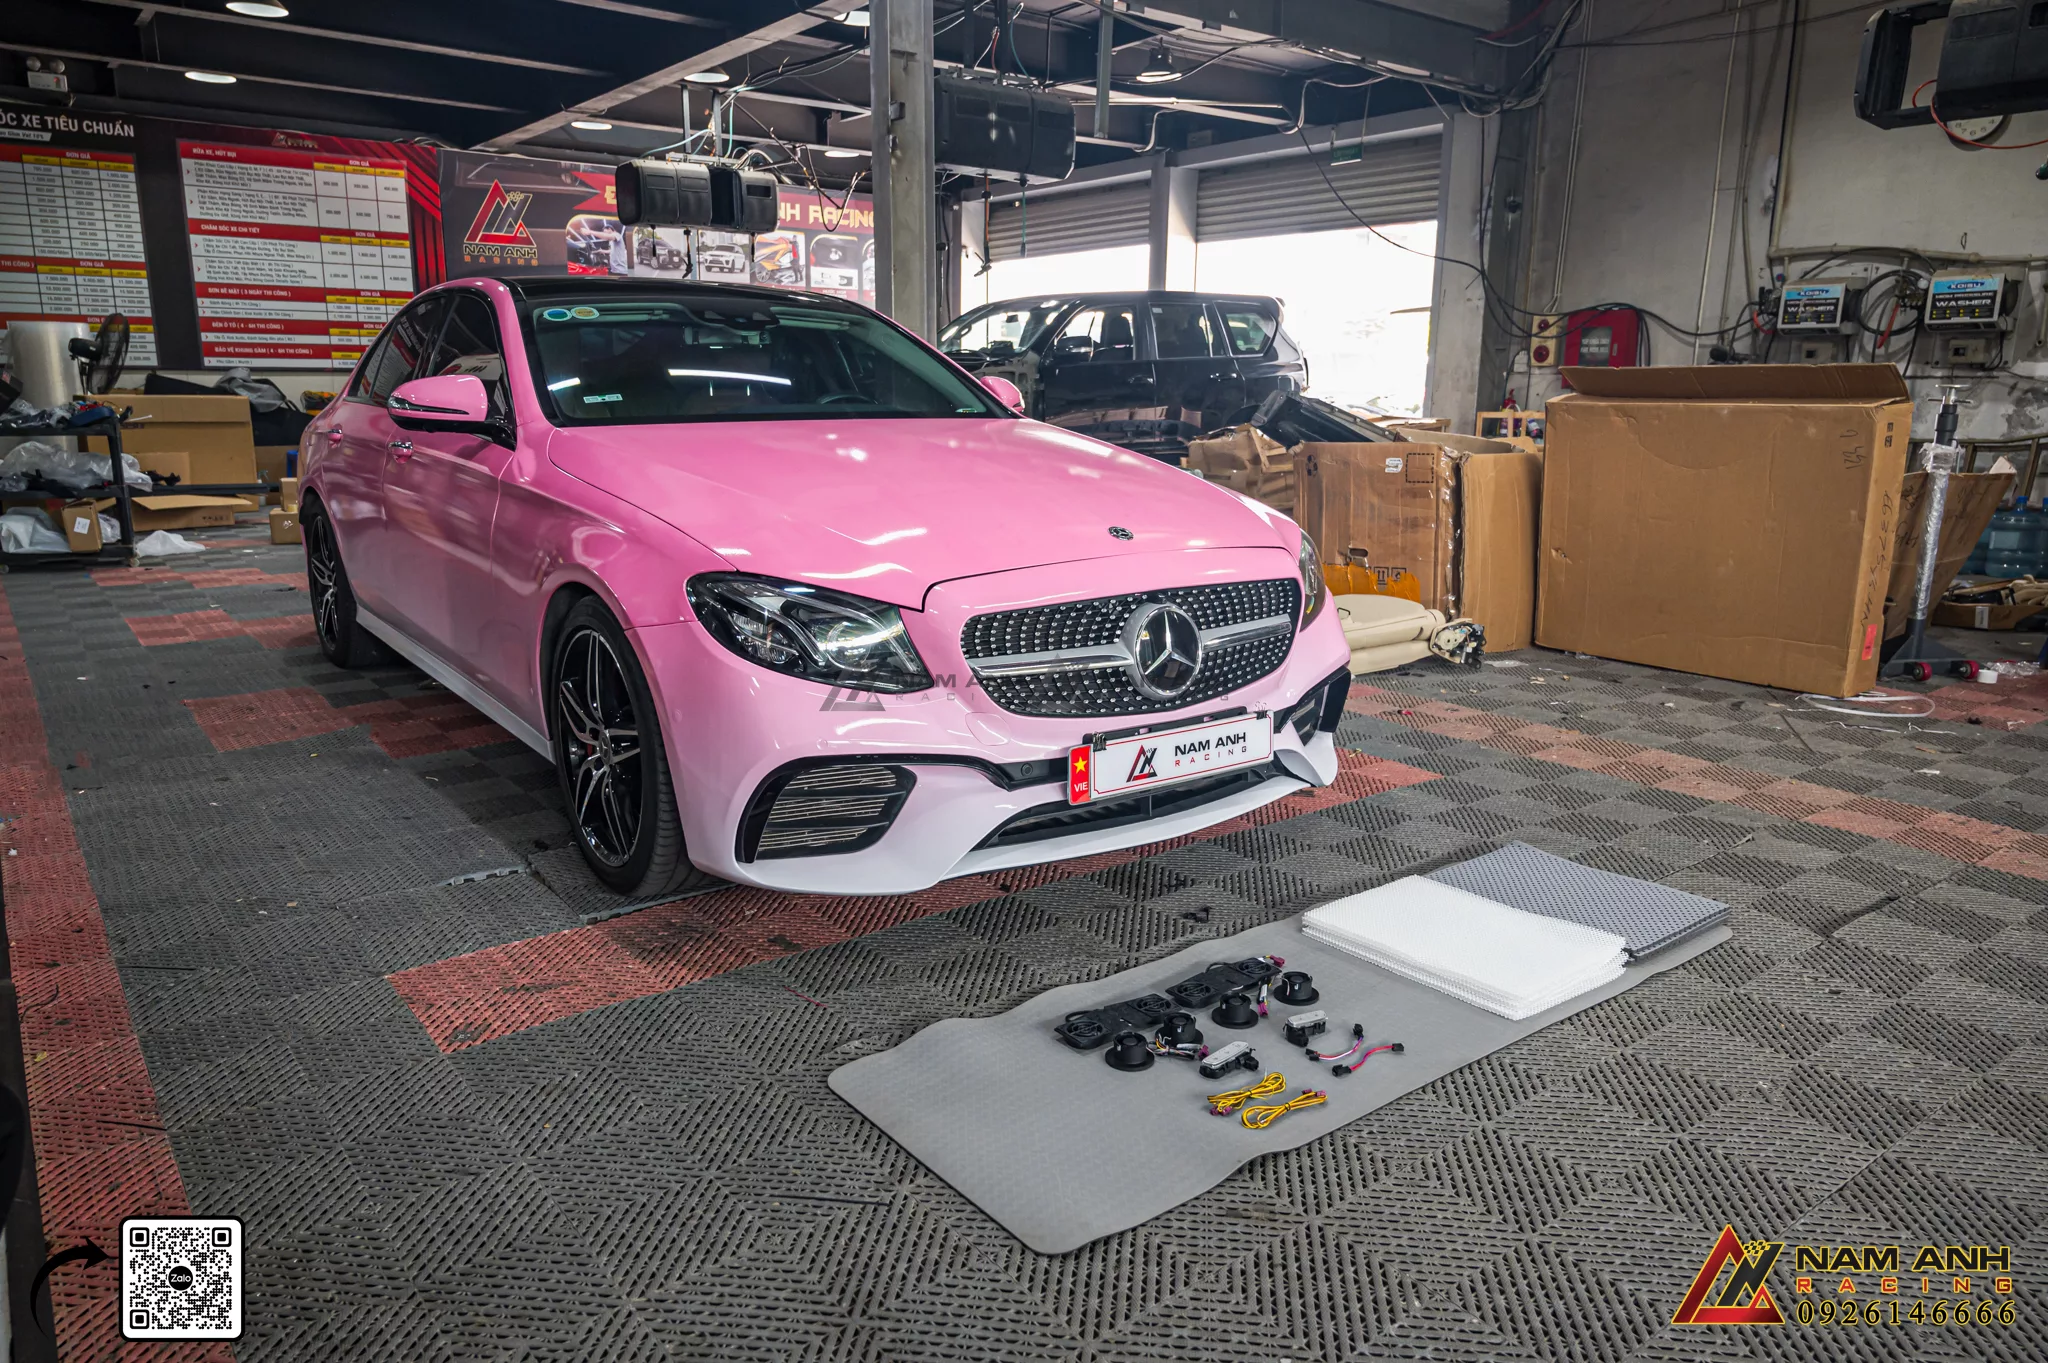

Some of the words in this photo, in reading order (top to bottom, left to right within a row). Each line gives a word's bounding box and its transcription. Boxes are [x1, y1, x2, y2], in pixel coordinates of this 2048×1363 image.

[21, 114, 42, 128] XE
[44, 115, 79, 132] TIÊU
[83, 120, 135, 137] CHUẨN
[779, 202, 800, 222] NH
[464, 244, 501, 256] NAM
[504, 247, 537, 258] ANH
[464, 255, 539, 266] RACING
[1936, 299, 1991, 307] WASHER
[1174, 739, 1210, 757] NAM
[1215, 732, 1247, 748] ANH
[1175, 746, 1247, 767] RACING
[1074, 781, 1088, 793] VIE
